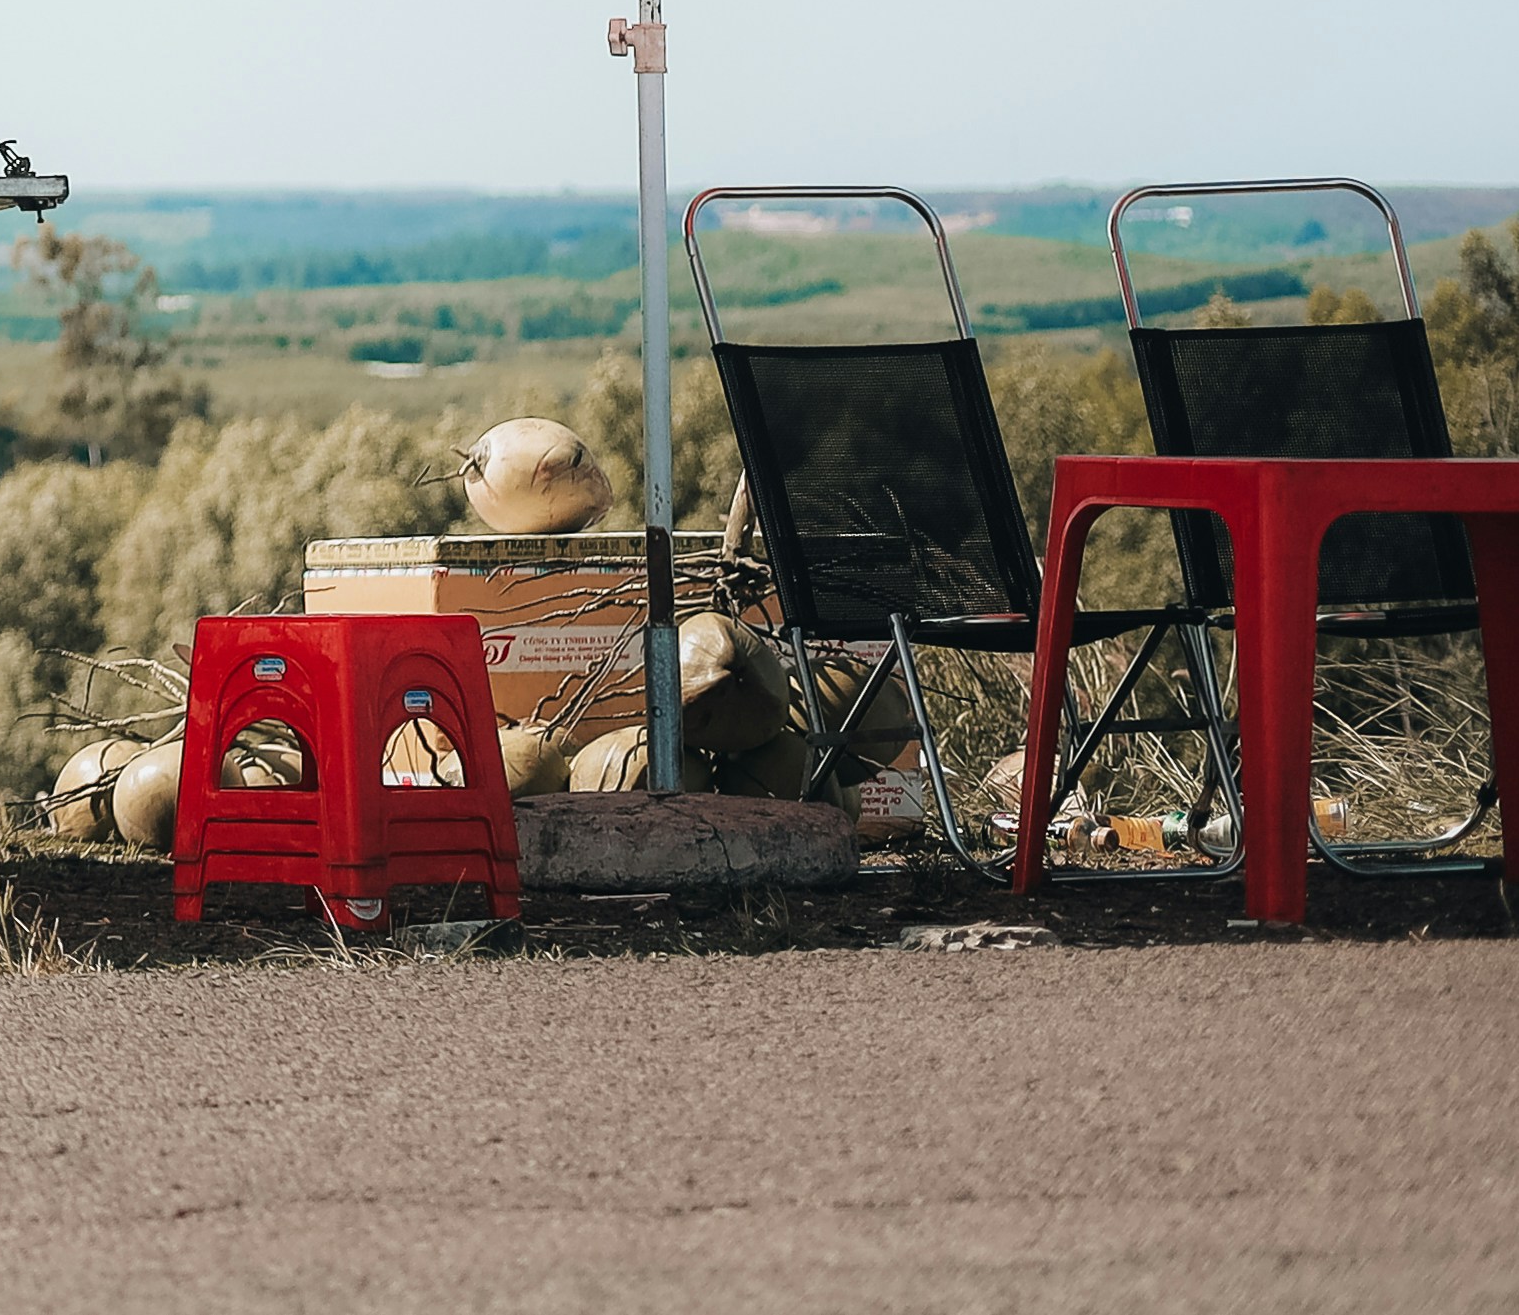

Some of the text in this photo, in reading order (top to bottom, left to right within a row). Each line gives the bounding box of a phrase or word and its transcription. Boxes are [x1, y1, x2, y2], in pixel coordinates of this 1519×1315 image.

[859, 786, 905, 796] Check Co
[890, 796, 902, 806] Or
